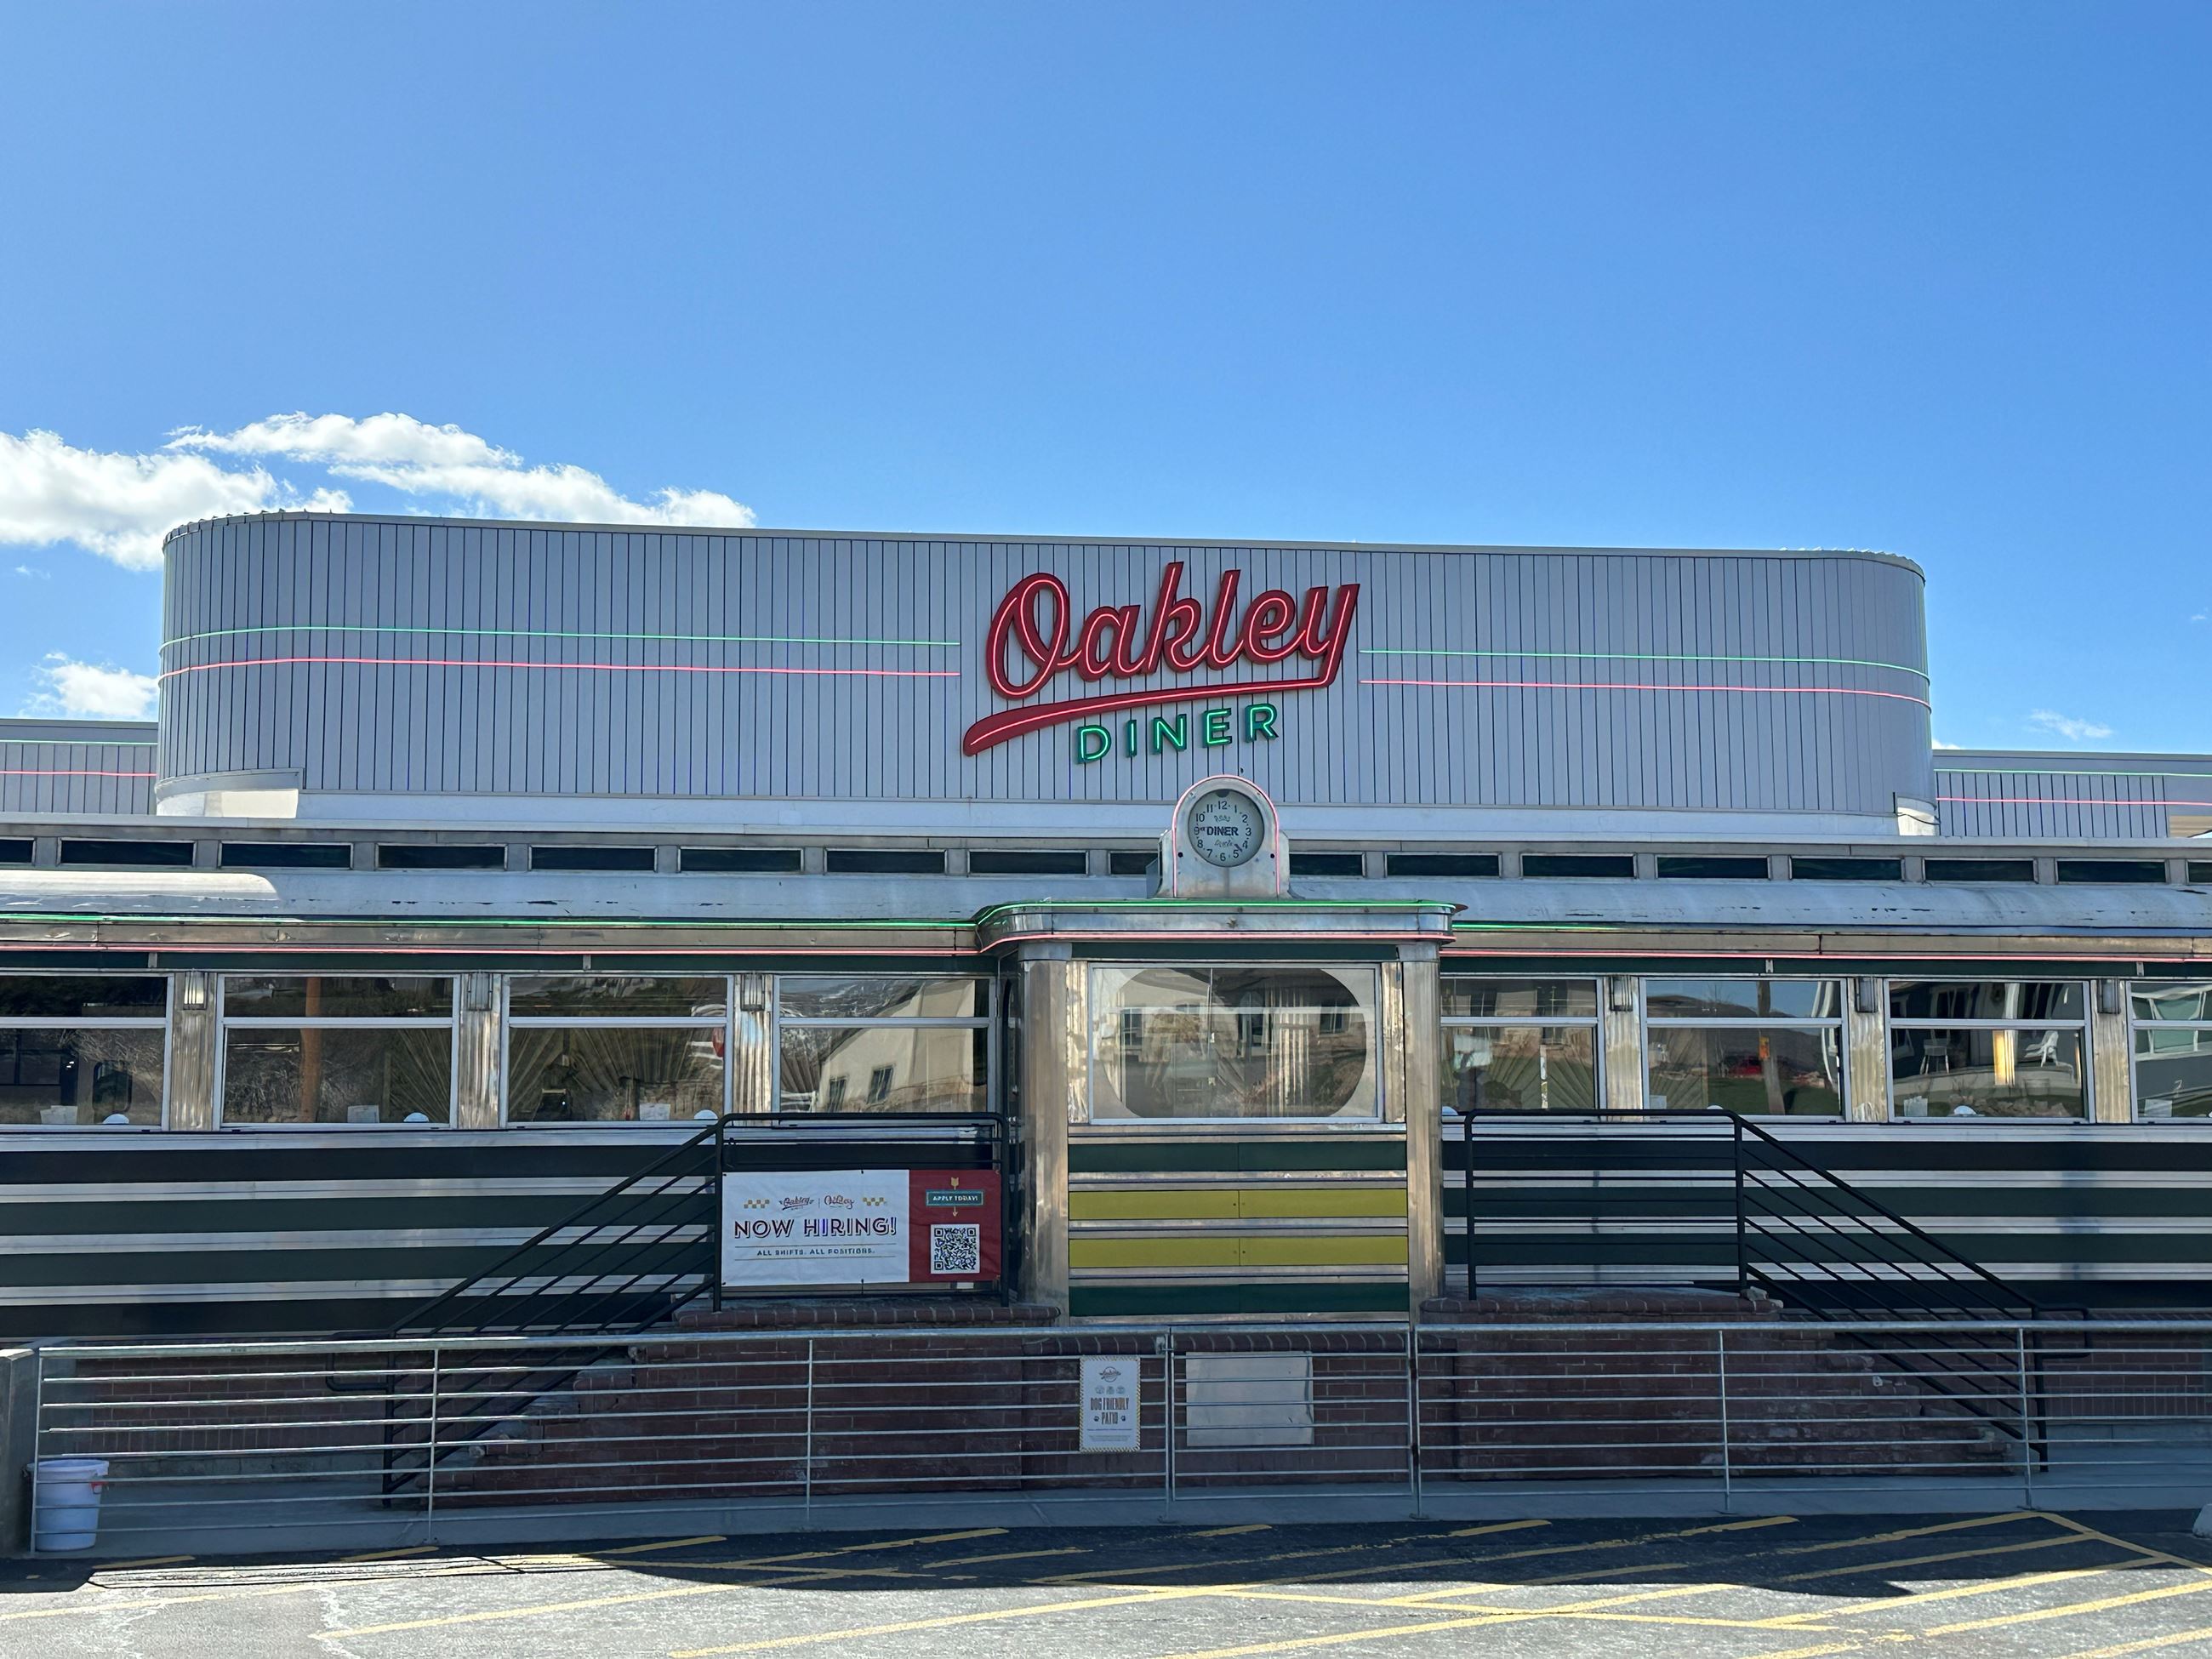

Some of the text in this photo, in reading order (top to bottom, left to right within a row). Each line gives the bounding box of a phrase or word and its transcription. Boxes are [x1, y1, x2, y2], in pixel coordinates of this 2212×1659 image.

[986, 561, 1360, 700] Oakley
[1076, 703, 1279, 764] DINER
[1206, 804, 1212, 812] 11
[1218, 801, 1228, 809] 12
[1234, 804, 1237, 813] 1
[1196, 813, 1205, 822] 10
[1242, 814, 1248, 823] 2
[1206, 826, 1239, 835] DINER
[1246, 827, 1251, 835] 3
[1197, 839, 1203, 848] 8
[1242, 841, 1247, 849] 4
[1206, 848, 1212, 858] 7
[1220, 852, 1226, 861] 6
[1233, 849, 1239, 858] 5
[734, 1217, 898, 1240] NOW HIRING!
[1090, 1397, 1103, 1411] DOG
[1101, 1411, 1119, 1425] PATIO
